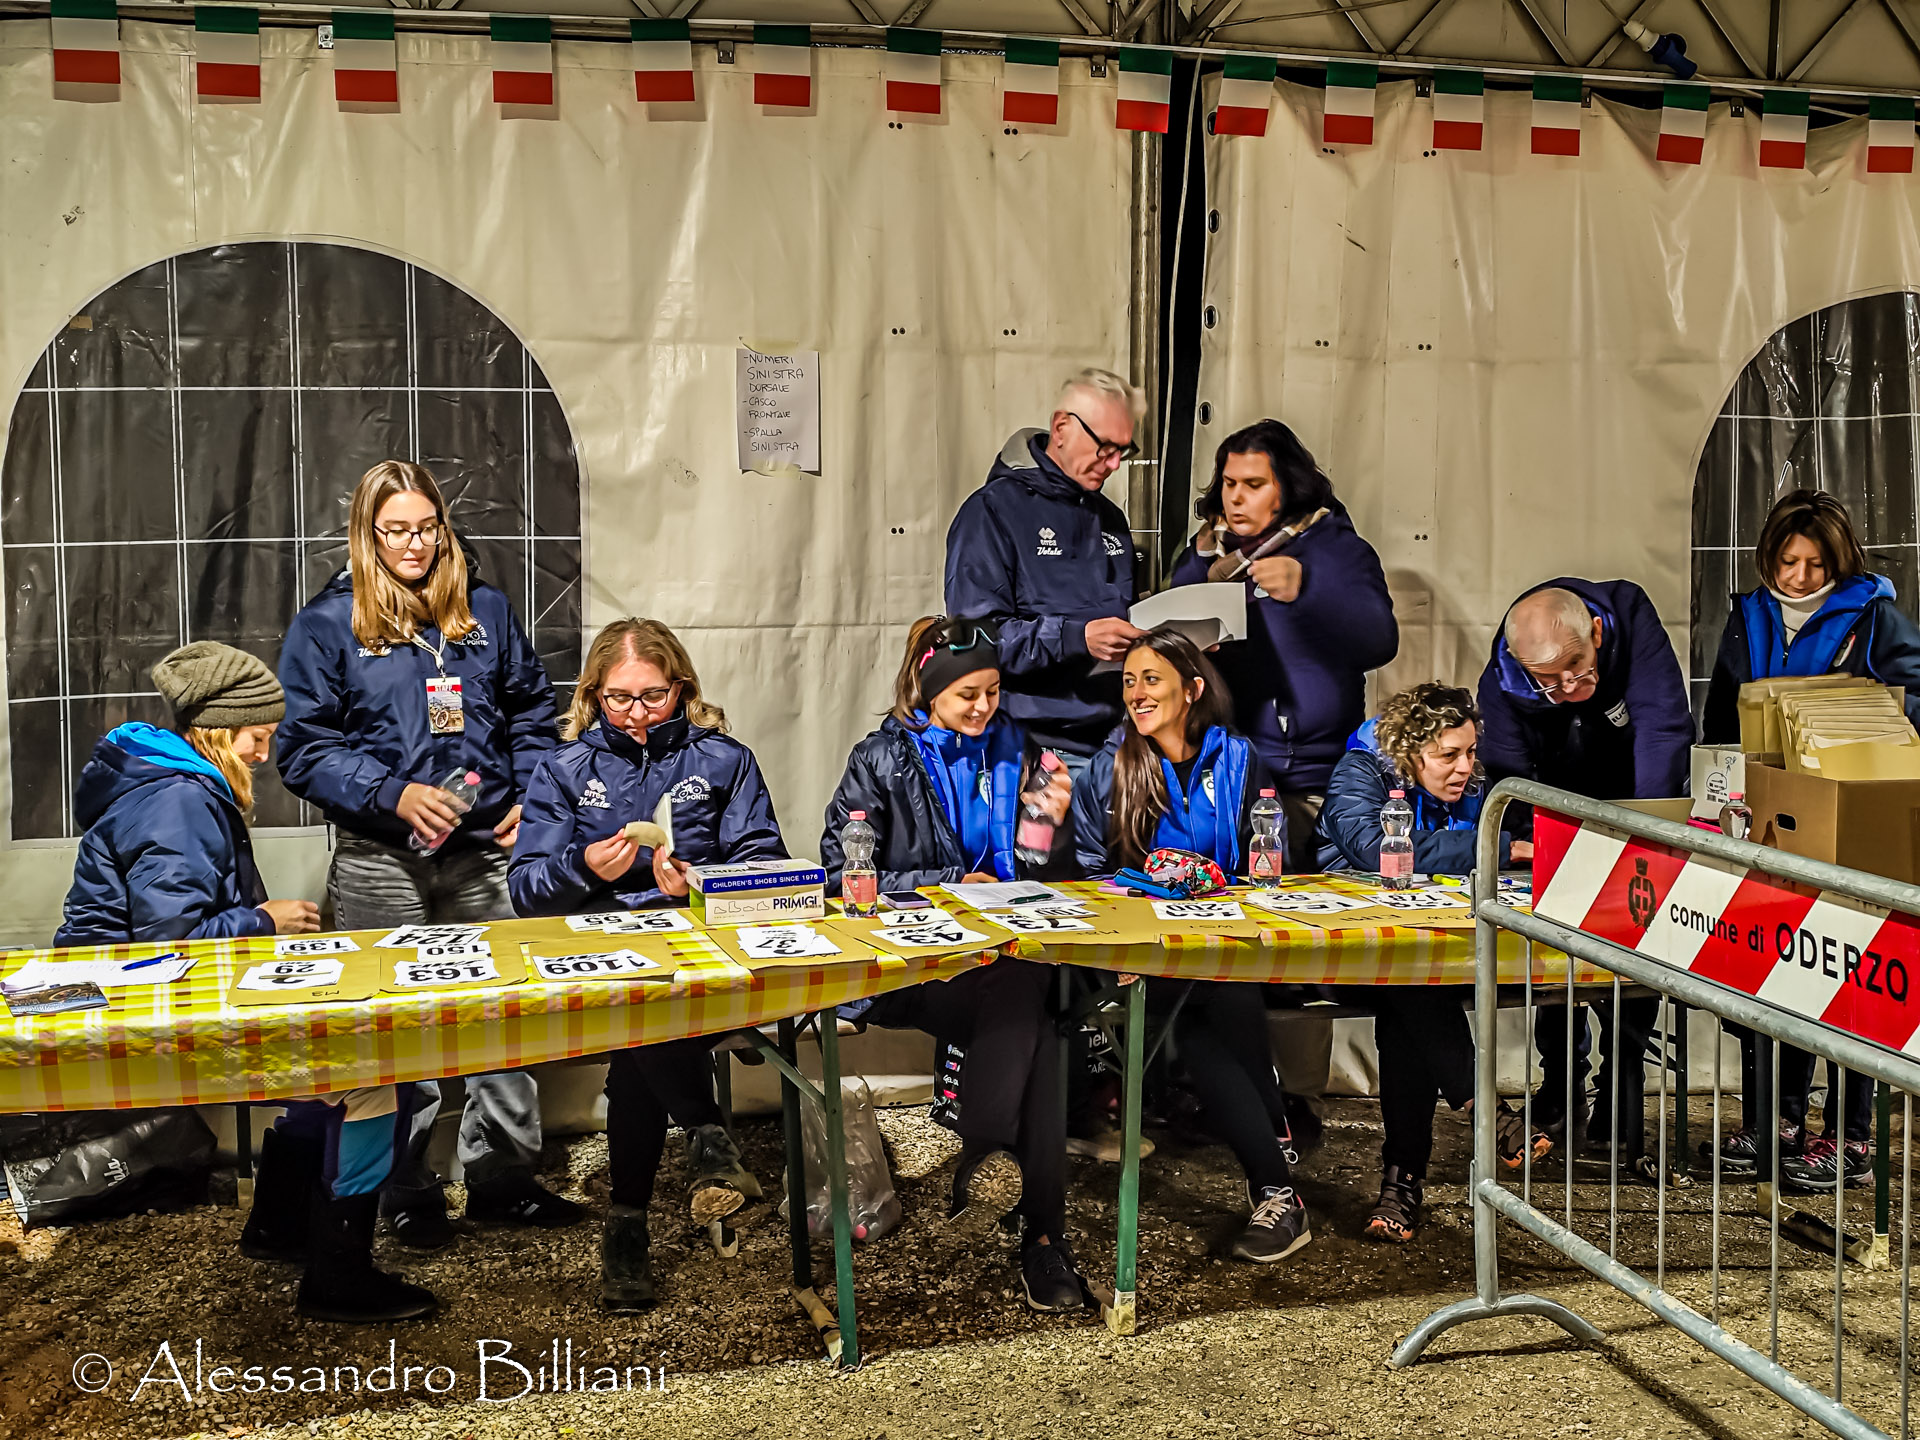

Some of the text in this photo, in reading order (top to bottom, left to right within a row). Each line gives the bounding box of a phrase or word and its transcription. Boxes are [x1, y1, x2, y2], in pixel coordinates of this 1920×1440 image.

[747, 367, 804, 379] SINISTRA
[751, 442, 799, 452] SINISTRA
[712, 880, 752, 889] CHILDREN'S
[754, 877, 777, 885] SHOES
[773, 896, 818, 910] PRIMIGI
[585, 915, 622, 925] 55
[896, 914, 929, 924] 47
[395, 933, 470, 946] 124
[904, 930, 963, 943] 43
[289, 941, 348, 952] 139
[757, 937, 794, 949] 37
[426, 944, 490, 956] 150
[1670, 903, 1909, 1002] comune di ODERZO
[275, 961, 314, 974] 29
[545, 959, 622, 975] 109
[409, 966, 486, 982] 163
